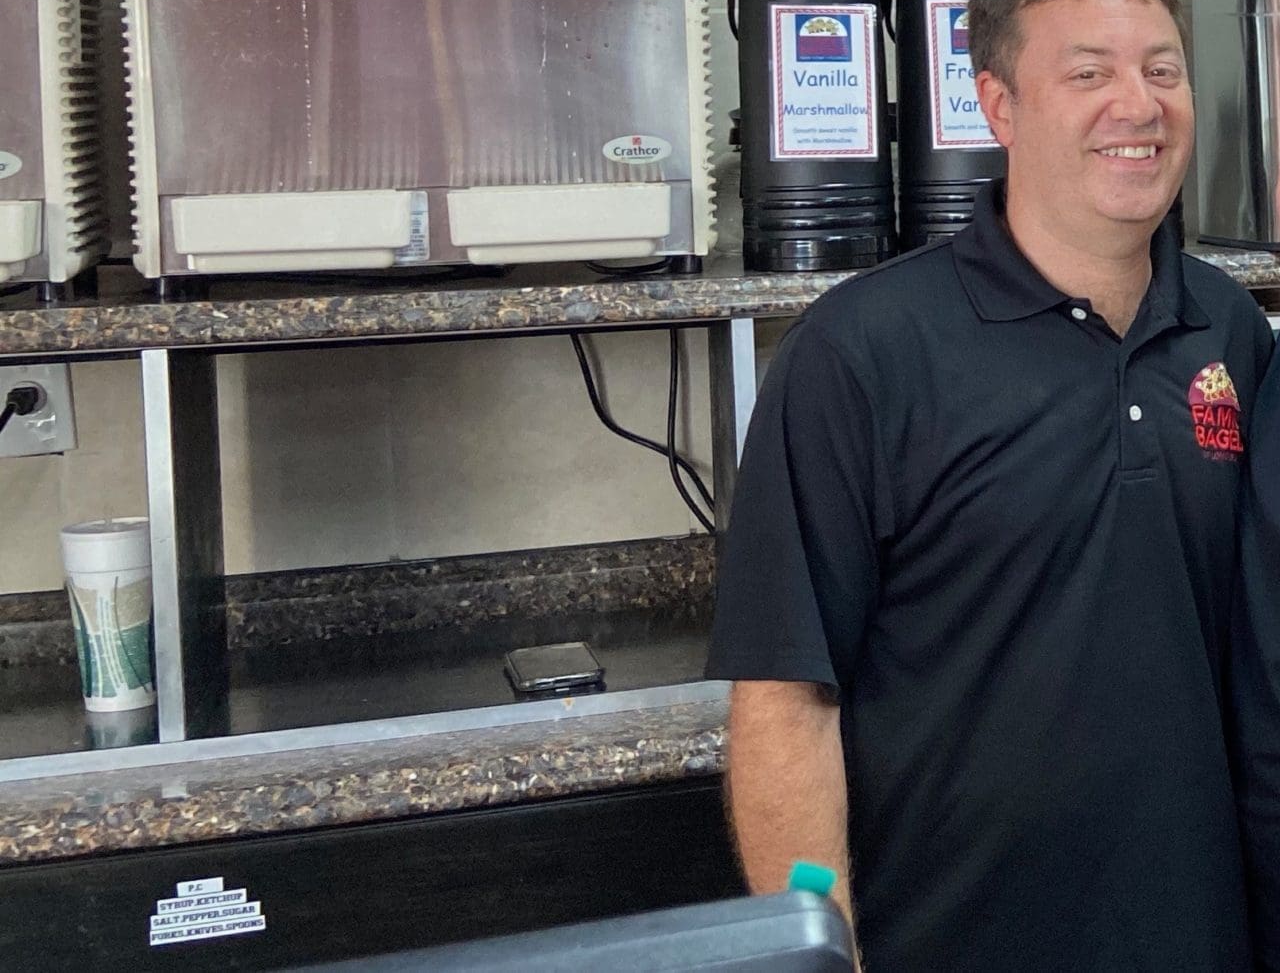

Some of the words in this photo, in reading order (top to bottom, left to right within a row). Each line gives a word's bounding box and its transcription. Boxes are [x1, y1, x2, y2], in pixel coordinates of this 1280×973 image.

[793, 69, 858, 87] Vanilla
[783, 103, 868, 116] Marshmallow
[613, 146, 659, 157] Crathco
